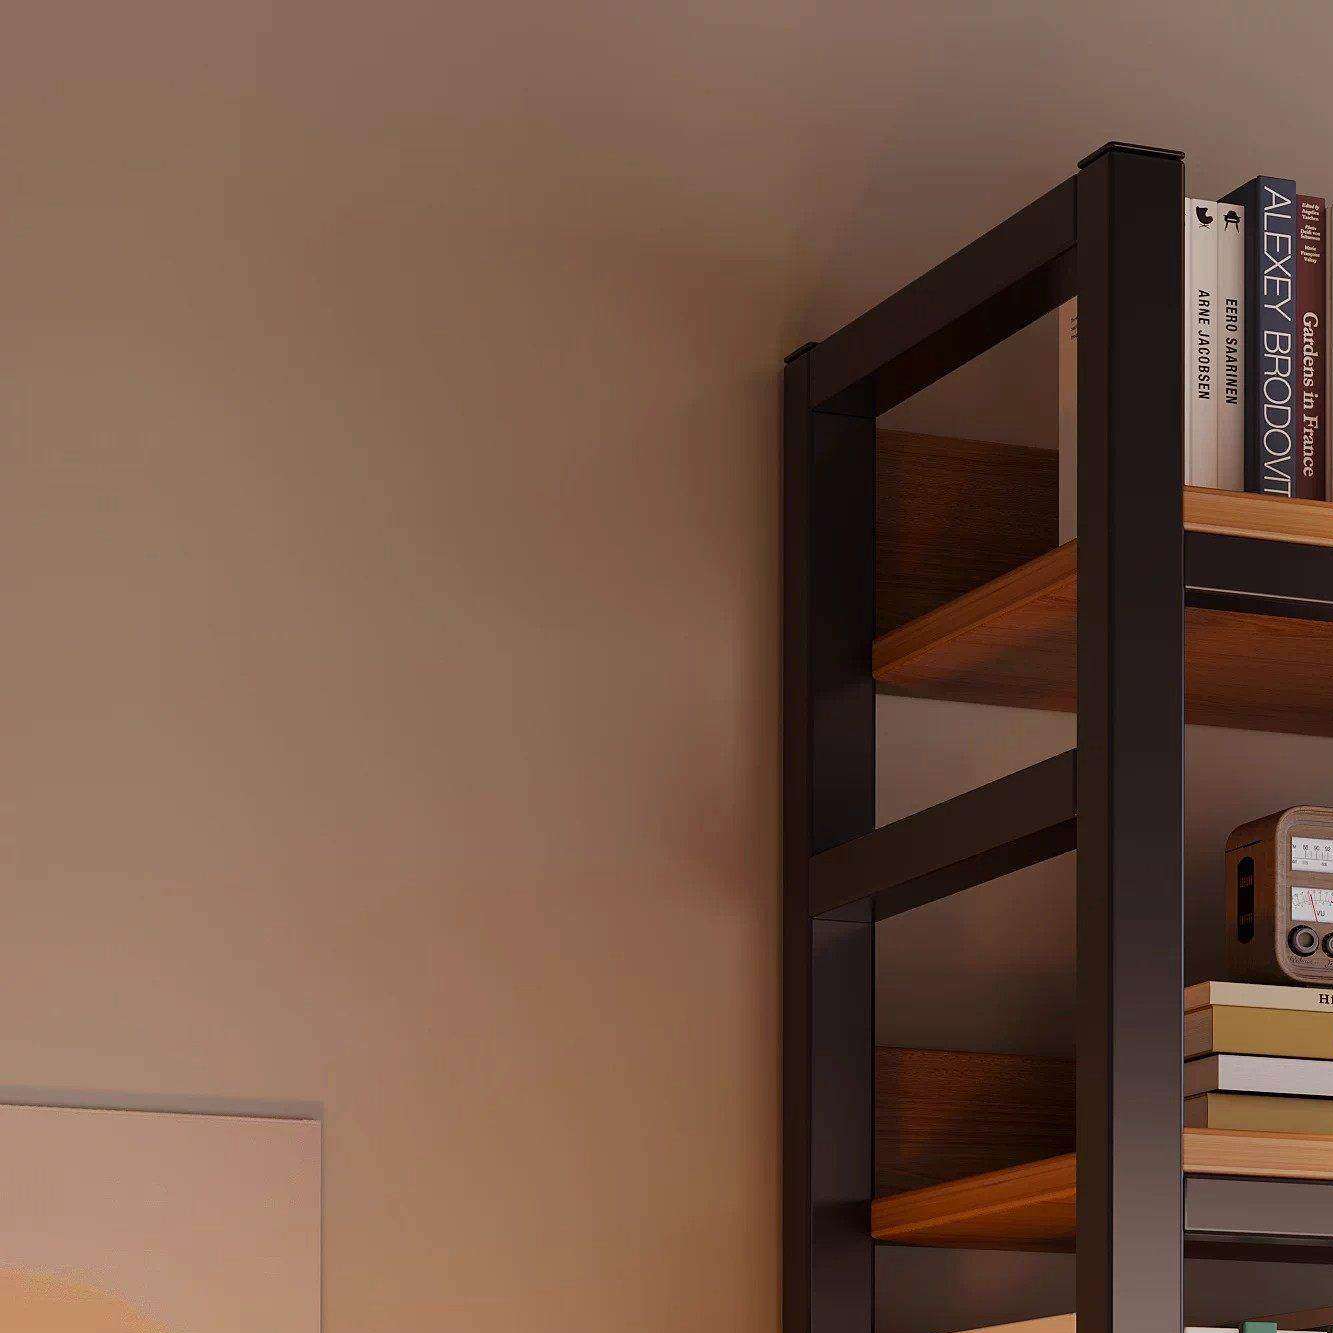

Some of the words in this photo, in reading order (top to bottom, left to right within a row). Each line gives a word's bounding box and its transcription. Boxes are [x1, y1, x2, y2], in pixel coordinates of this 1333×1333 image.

[1264, 186, 1292, 322] ALEXEY
[1197, 288, 1210, 329] ARNE
[1225, 297, 1238, 331] EERO
[1197, 331, 1210, 401] JACOBSEN
[1224, 336, 1238, 404] SAARINEN
[1302, 311, 1319, 387] Gardens
[1303, 389, 1319, 411] in
[1302, 415, 1319, 478] France
